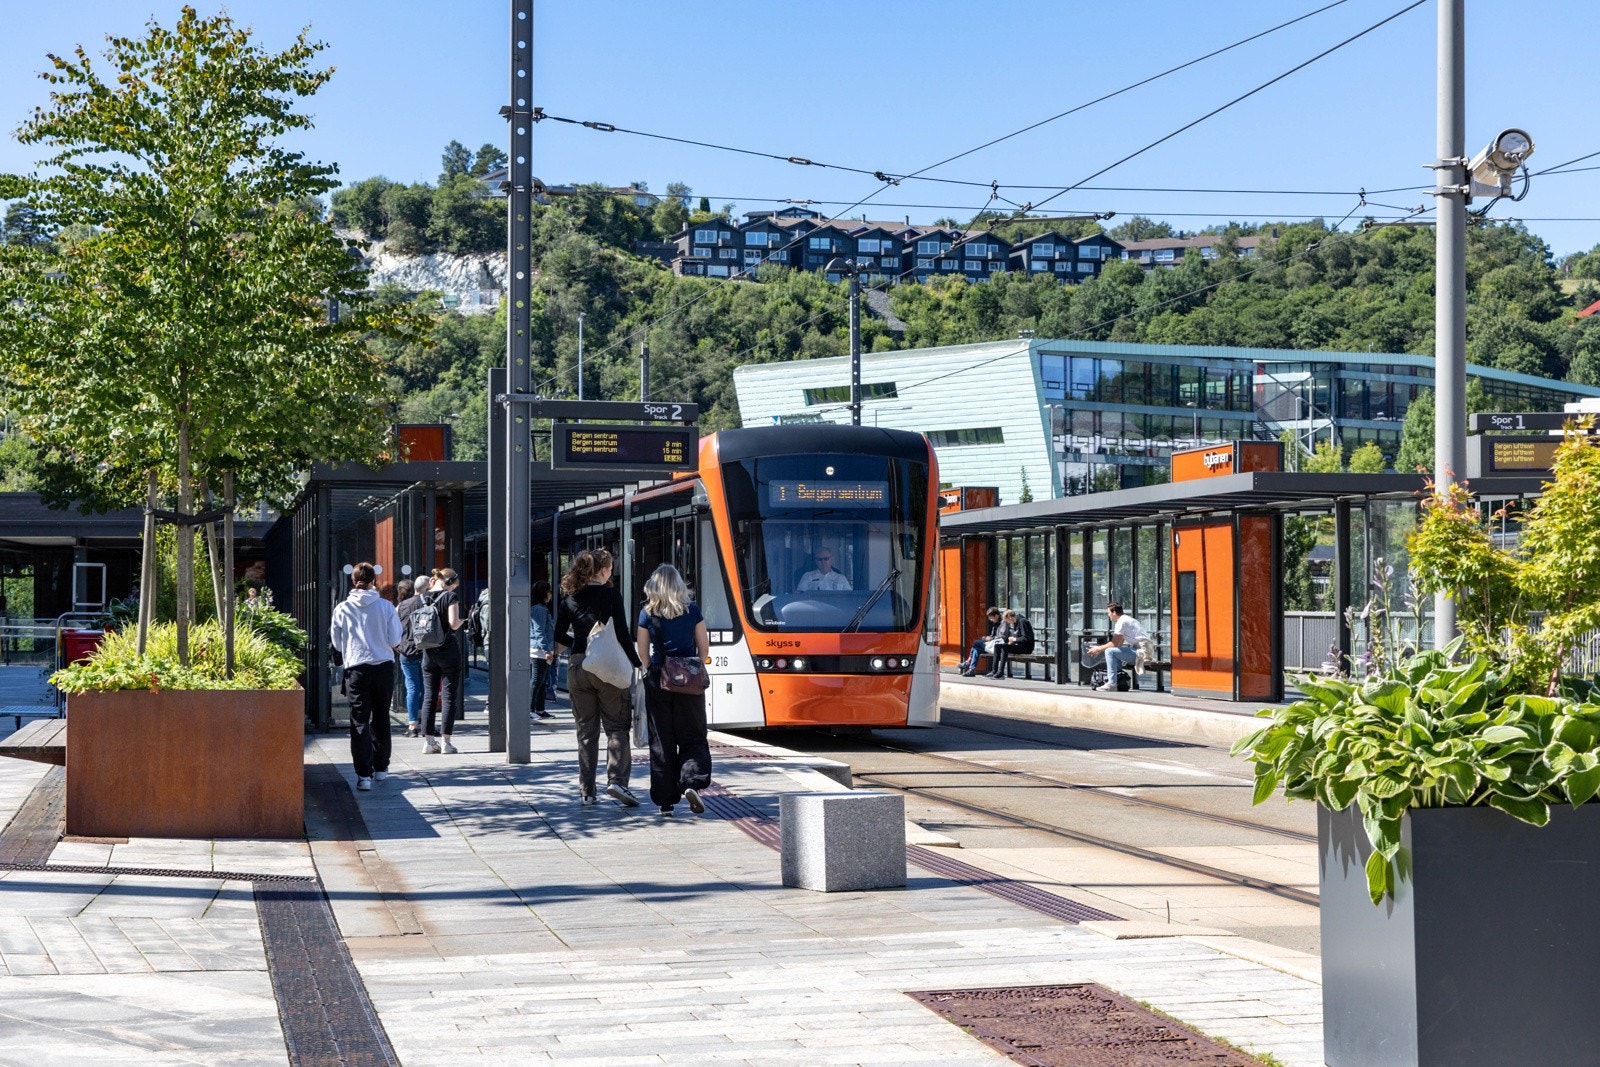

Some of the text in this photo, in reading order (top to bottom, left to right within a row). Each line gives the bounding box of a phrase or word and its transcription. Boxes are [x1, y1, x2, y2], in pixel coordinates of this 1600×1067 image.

[643, 404, 682, 420] Spor 2
[1491, 415, 1526, 429] Spor 1
[1203, 452, 1229, 468] bybanen
[798, 484, 836, 502] Bergen
[838, 484, 882, 499] sentrum
[766, 639, 794, 648] skyss
[715, 656, 728, 666] 216
